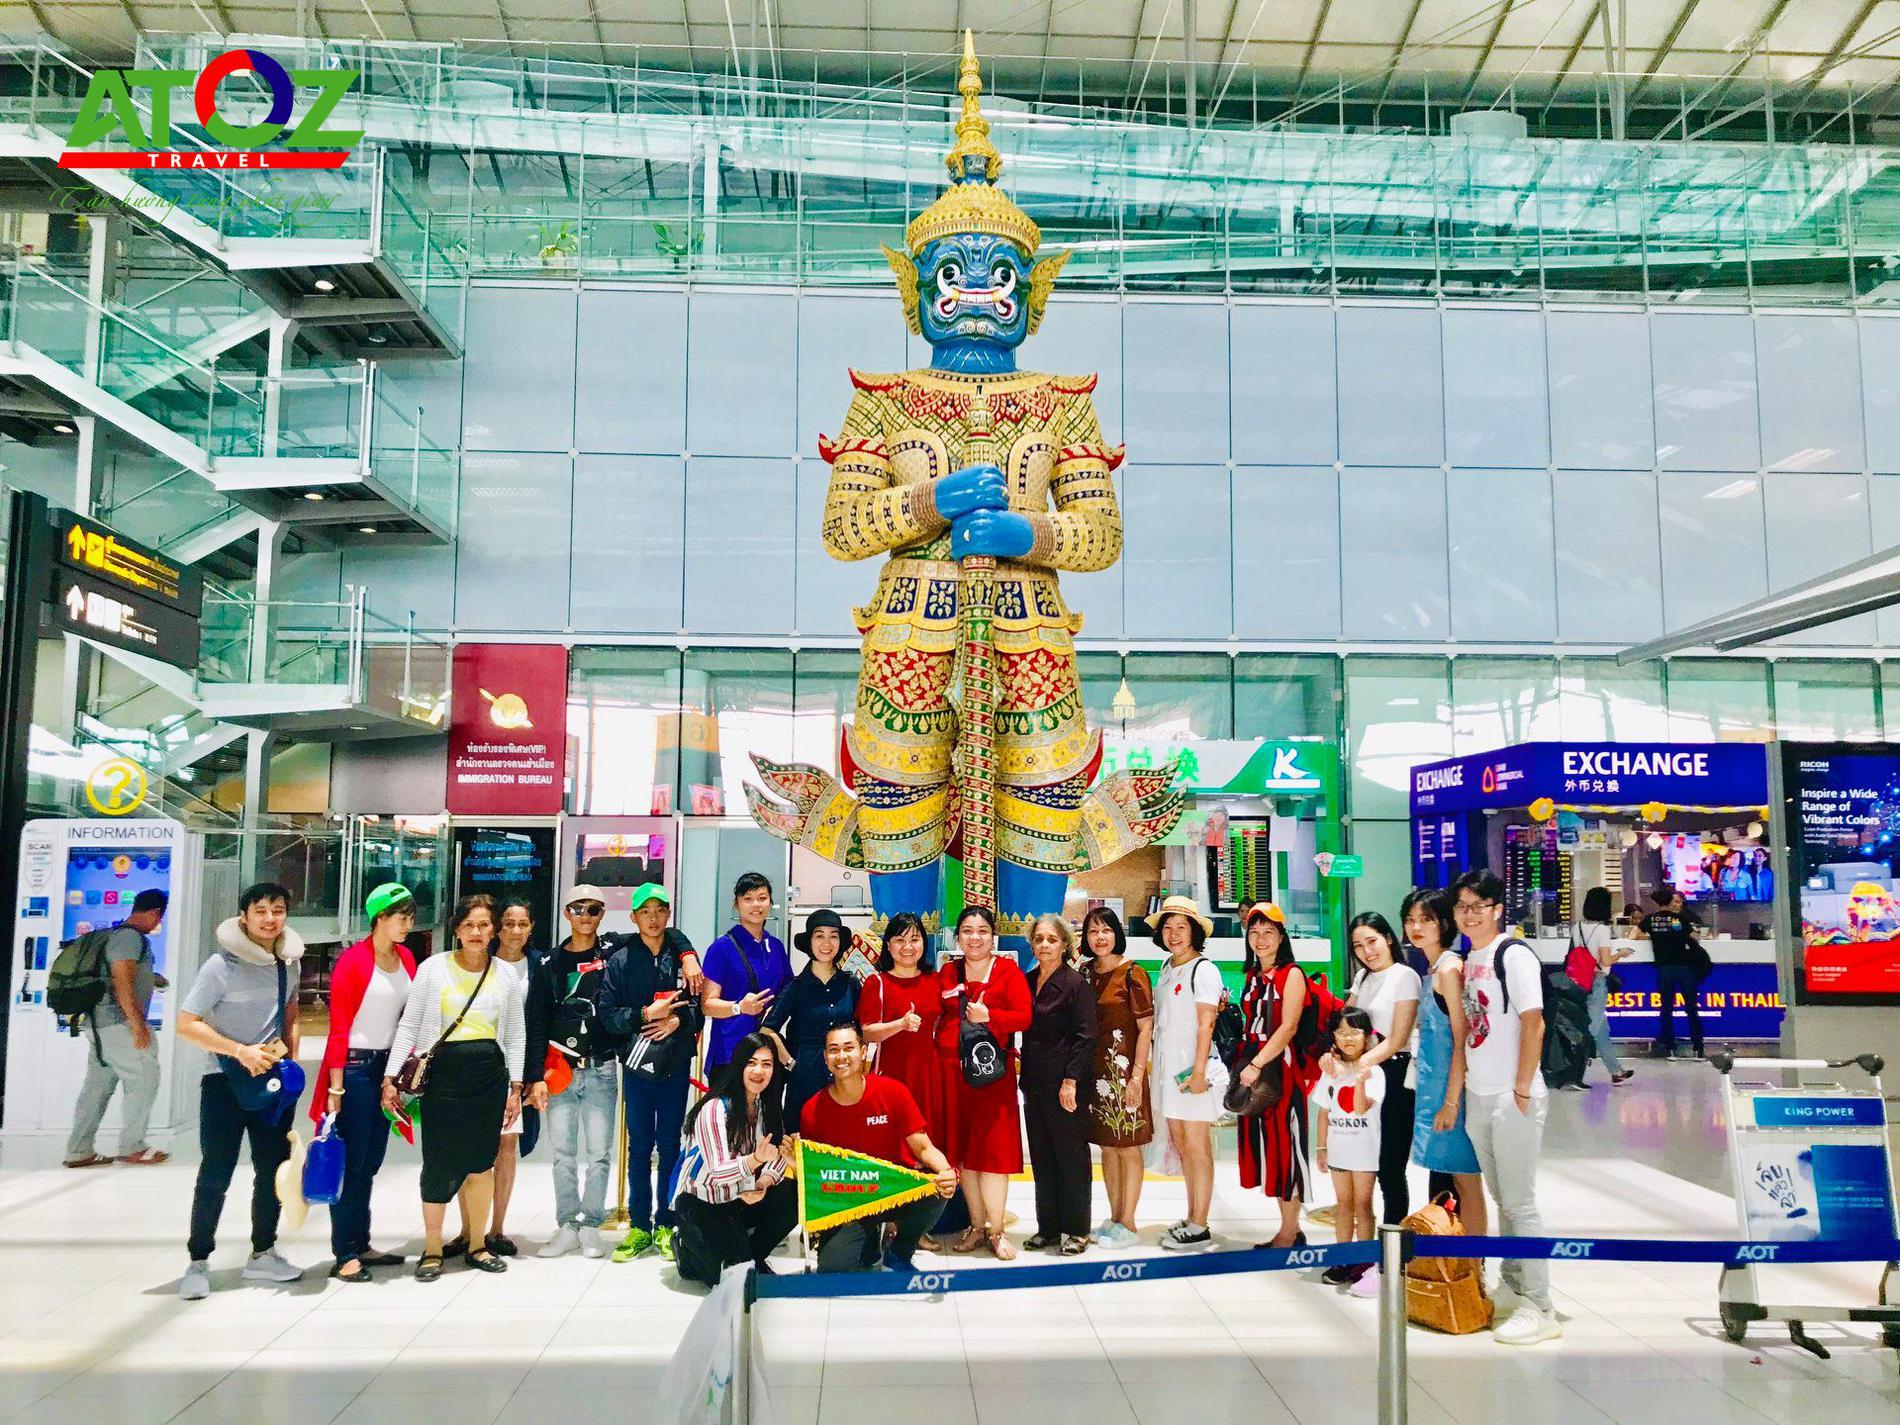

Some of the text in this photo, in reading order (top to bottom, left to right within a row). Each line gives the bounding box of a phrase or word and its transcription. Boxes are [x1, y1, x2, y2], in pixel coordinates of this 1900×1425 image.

[1563, 751, 1709, 777] EXCHANGE
[457, 774, 553, 784] IMMIGRATION BUREAU
[1416, 765, 1464, 793] EXCHANGE
[1564, 779, 1620, 793] 外币兑换
[1801, 788, 1879, 800] Inspire a Wide
[1802, 801, 1851, 813] Range of
[1802, 814, 1880, 825] Vibrant Colors
[67, 826, 174, 839] INFORMATION
[1606, 992, 1646, 1007] BEST
[1706, 992, 1726, 1007] IN
[1784, 1107, 1855, 1117] KING POWER
[866, 1114, 888, 1126] PEACE
[820, 1169, 880, 1181] VIET NAM
[1551, 1241, 1594, 1257] AOT
[1736, 1245, 1780, 1260] AOT
[1286, 1248, 1328, 1265] AOT
[1102, 1263, 1147, 1280] AOT
[907, 1273, 955, 1290] AOT
